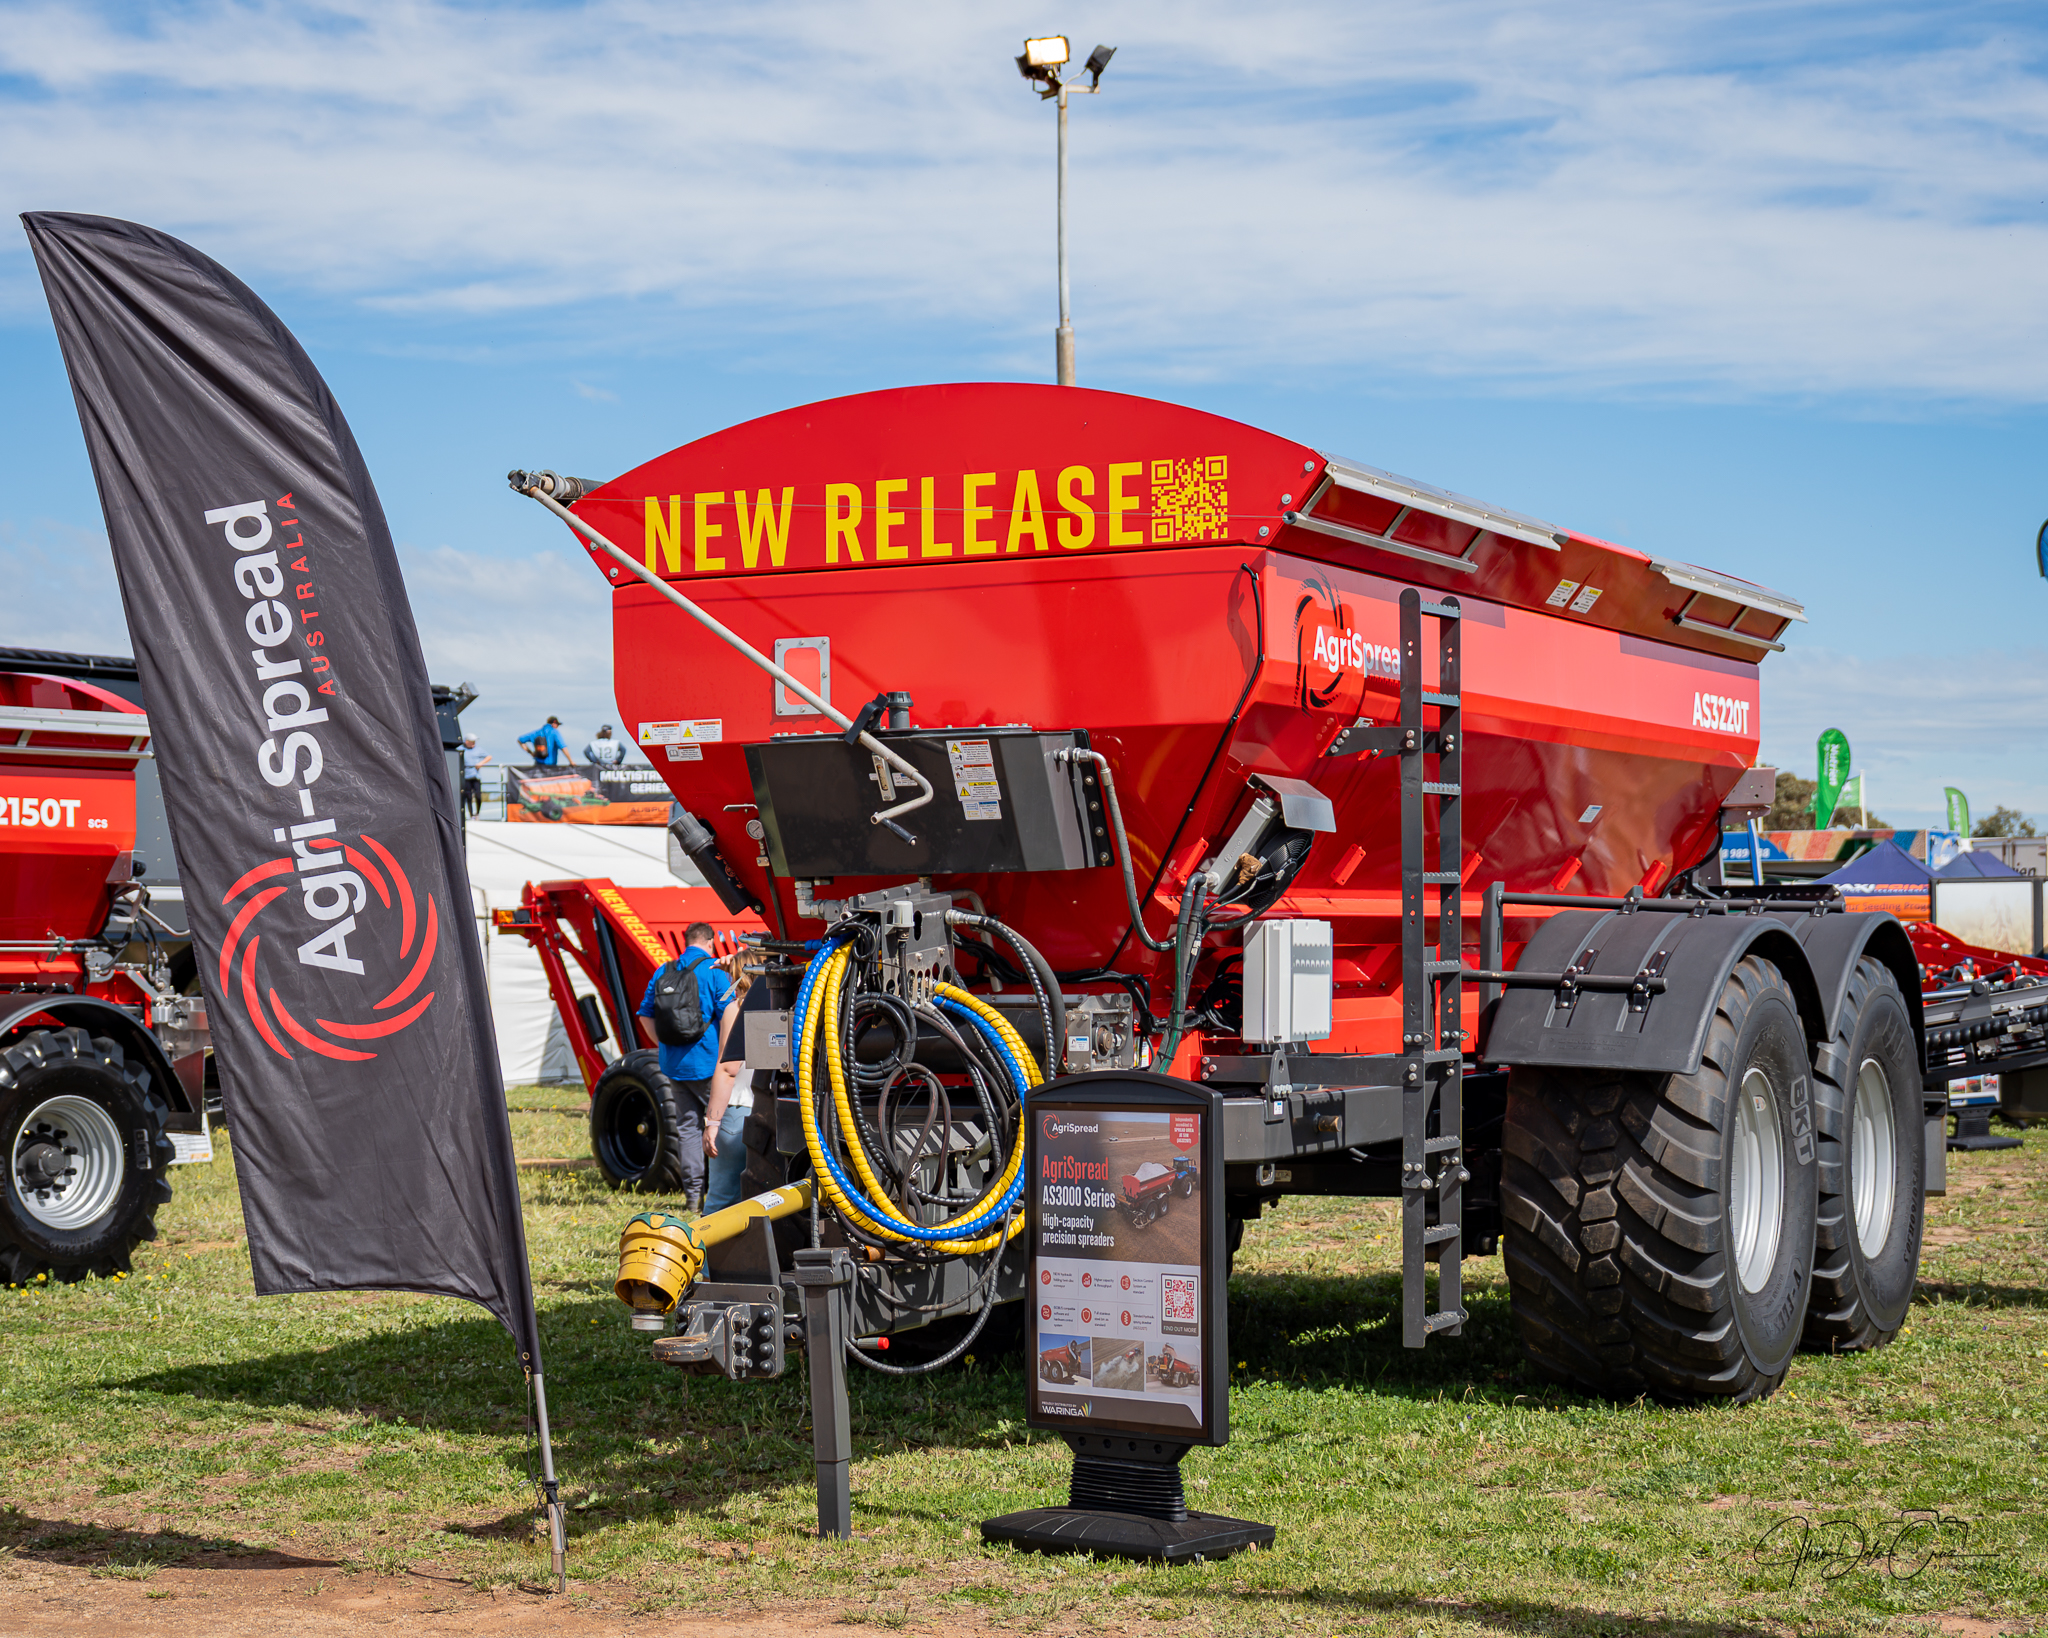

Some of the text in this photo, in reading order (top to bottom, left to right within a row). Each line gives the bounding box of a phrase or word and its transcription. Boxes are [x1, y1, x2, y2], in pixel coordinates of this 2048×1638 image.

[645, 461, 1144, 573] NEW RELEASE
[276, 491, 337, 695] AUSTRALIA
[1313, 625, 1400, 678] AgriSprea
[1692, 691, 1750, 735] AS3220T
[203, 500, 367, 976] Agri-Spread
[630, 783, 671, 794] SERIES
[597, 888, 673, 967] NEW RELEASE
[1052, 1122, 1099, 1135] AgriSpread
[1042, 1155, 1109, 1184] AgriSpread
[1042, 1185, 1116, 1209] AS3000 Series
[1042, 1212, 1094, 1232] High-capacity
[1042, 1230, 1115, 1248] precision spreaders
[1042, 1405, 1084, 1417] WARINGA
